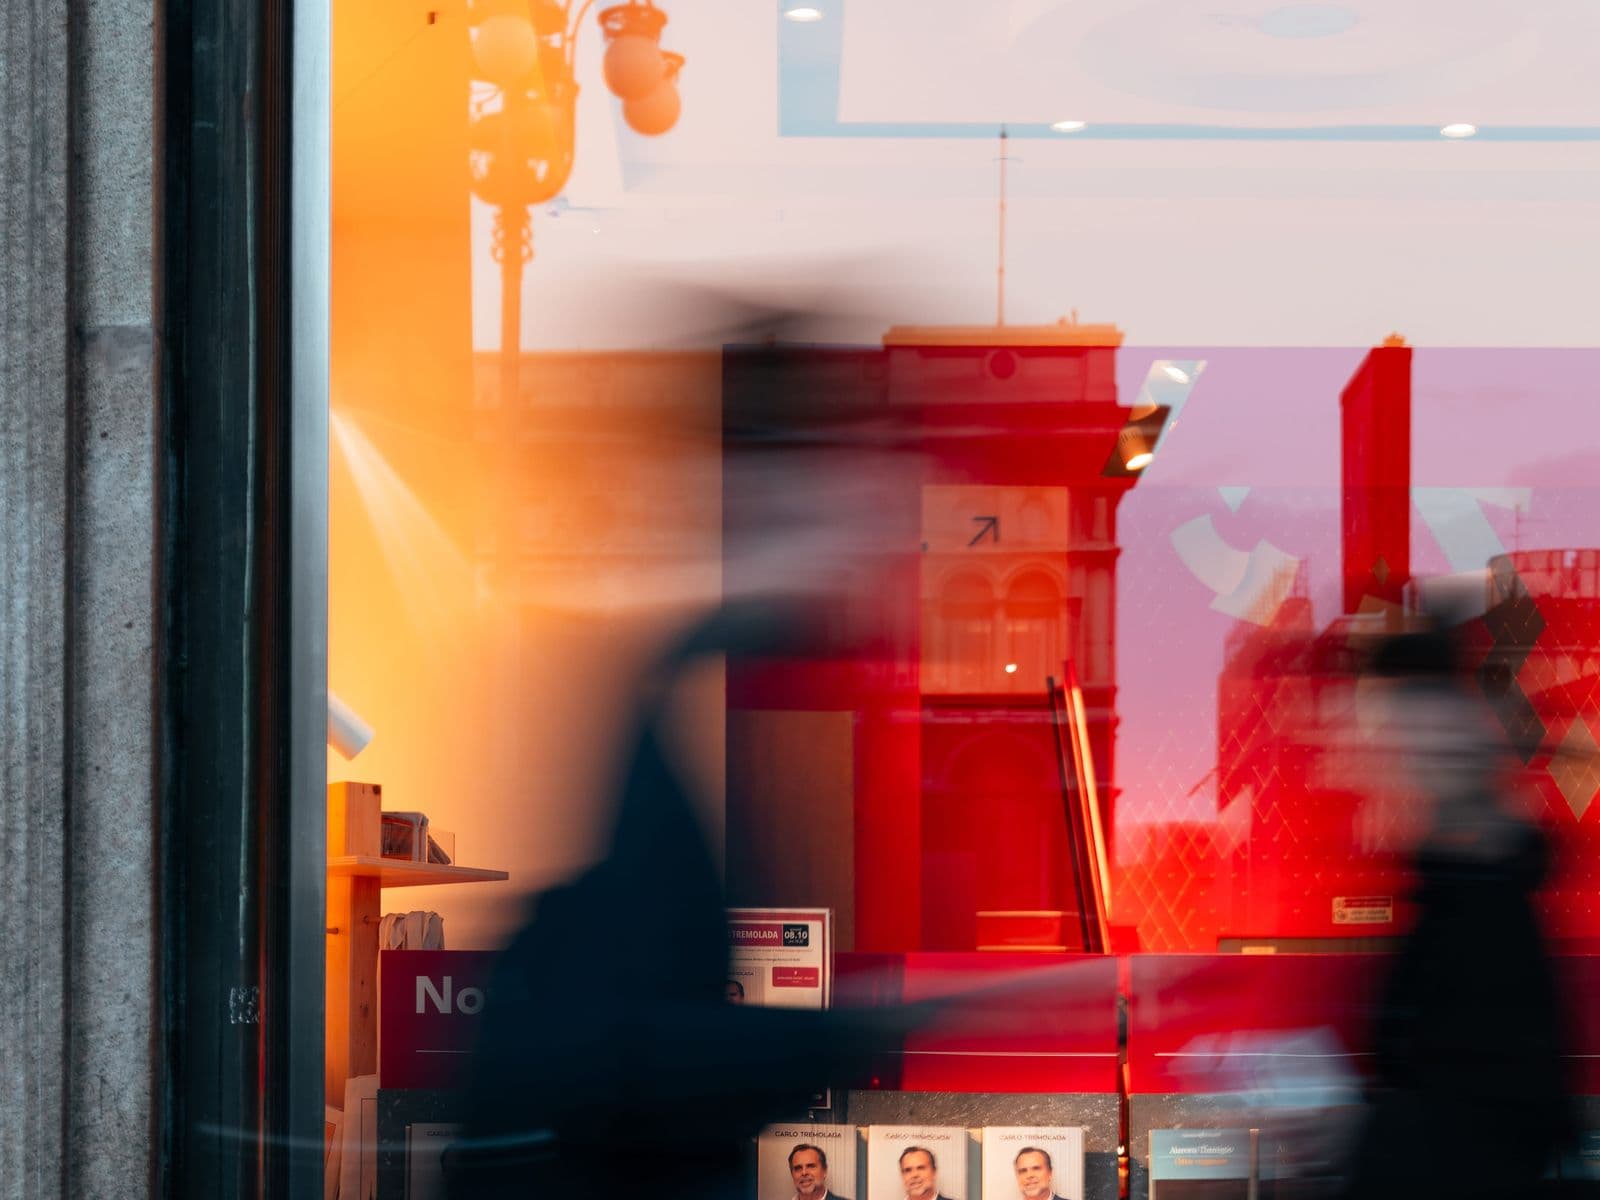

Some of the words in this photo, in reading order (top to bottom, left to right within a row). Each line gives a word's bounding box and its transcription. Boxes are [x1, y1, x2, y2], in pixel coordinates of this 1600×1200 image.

[732, 930, 779, 939] TREMOLADA
[784, 931, 808, 940] 08.10
[415, 975, 485, 1015] No
